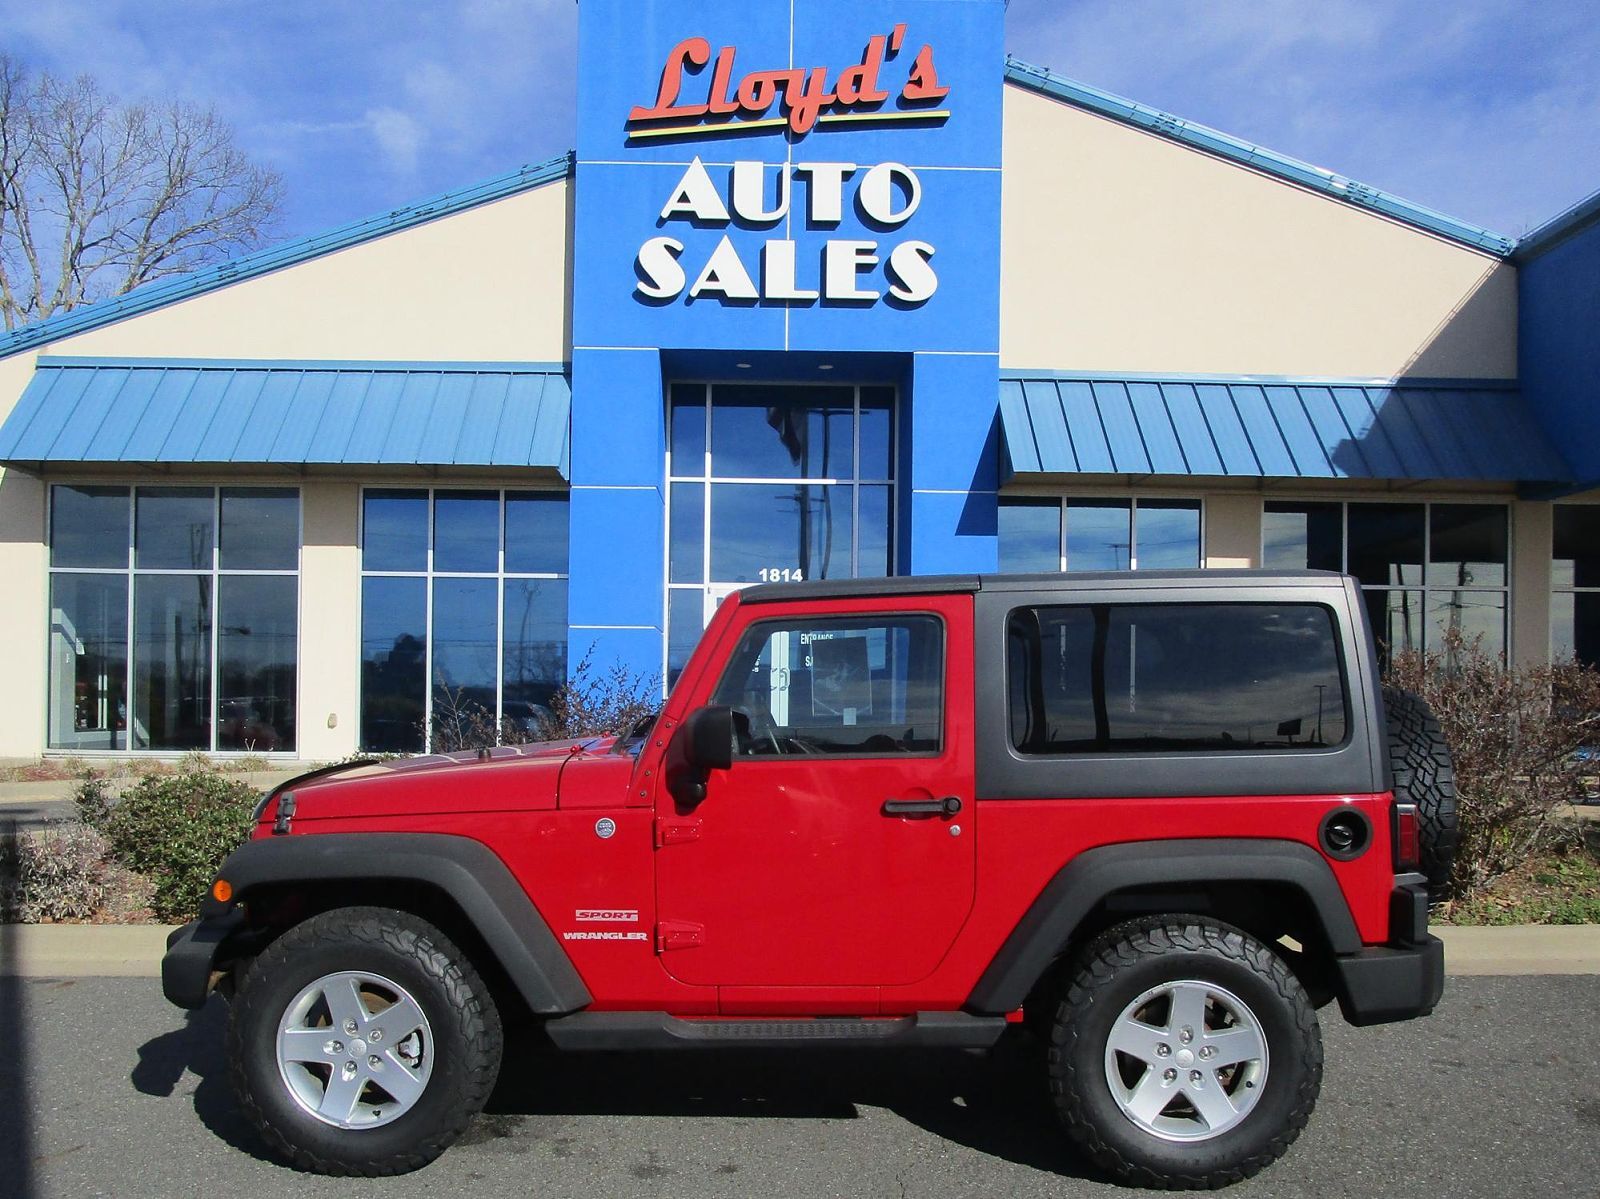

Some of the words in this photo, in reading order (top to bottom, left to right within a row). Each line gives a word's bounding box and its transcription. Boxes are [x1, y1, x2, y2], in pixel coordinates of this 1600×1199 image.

[628, 23, 951, 134] Lloyd's
[660, 155, 922, 223] AUTO
[635, 234, 939, 302] SALES
[758, 567, 804, 583] 1814
[563, 932, 648, 941] WRANGLER
[576, 911, 638, 920] SPORT
